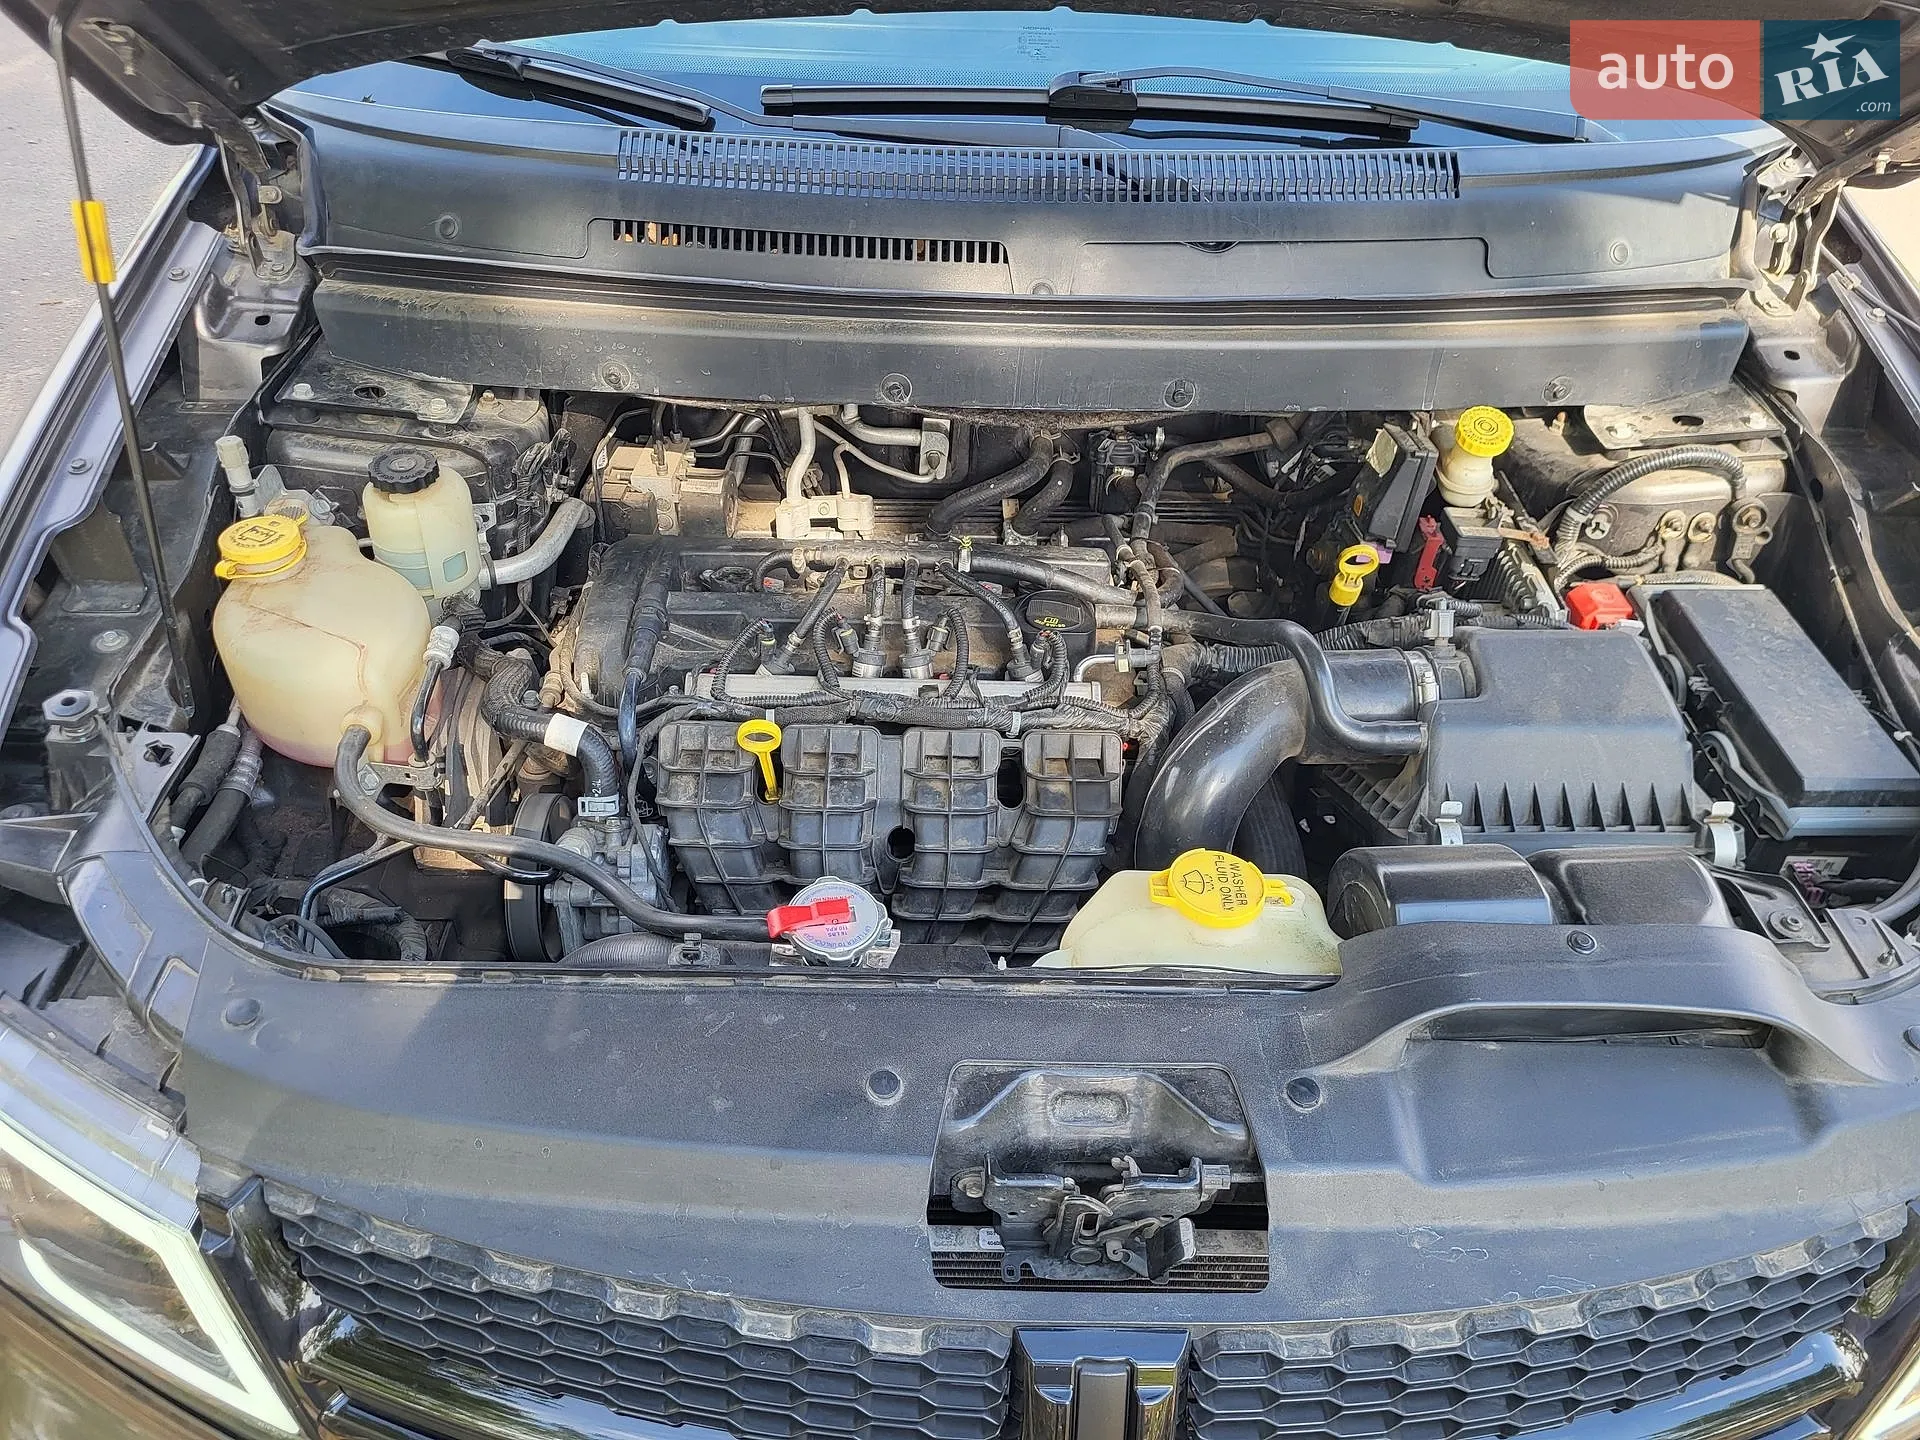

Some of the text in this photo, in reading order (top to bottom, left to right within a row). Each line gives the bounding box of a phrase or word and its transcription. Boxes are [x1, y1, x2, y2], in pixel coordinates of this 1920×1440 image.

[1213, 854, 1234, 912] FLUID ONLY
[1229, 862, 1248, 906] WASHER
